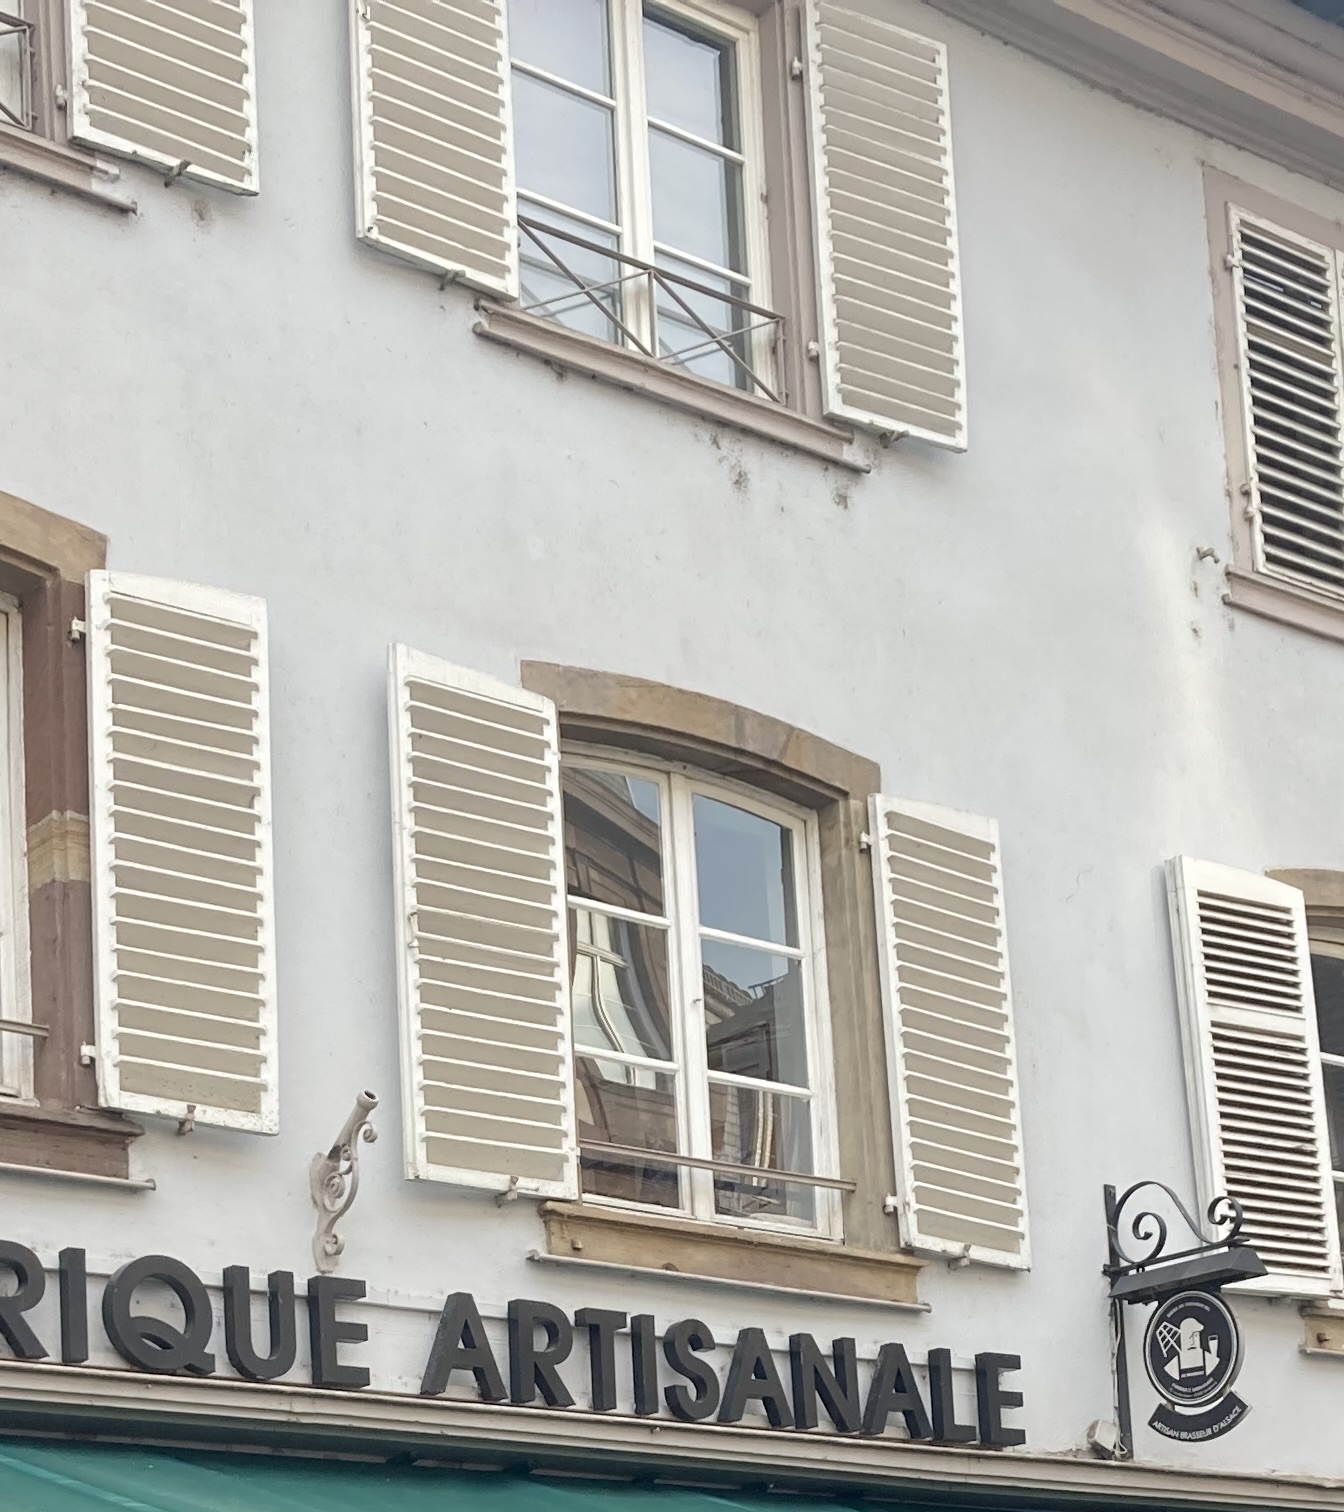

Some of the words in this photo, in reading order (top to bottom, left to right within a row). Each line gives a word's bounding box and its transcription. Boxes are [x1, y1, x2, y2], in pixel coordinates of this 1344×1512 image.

[419, 1291, 1026, 1447] ARTISANALE
[1152, 1421, 1179, 1438] ARTISAN
[1180, 1428, 1212, 1440] BRASSEUR
[1212, 1405, 1242, 1433] D'ALSACE
